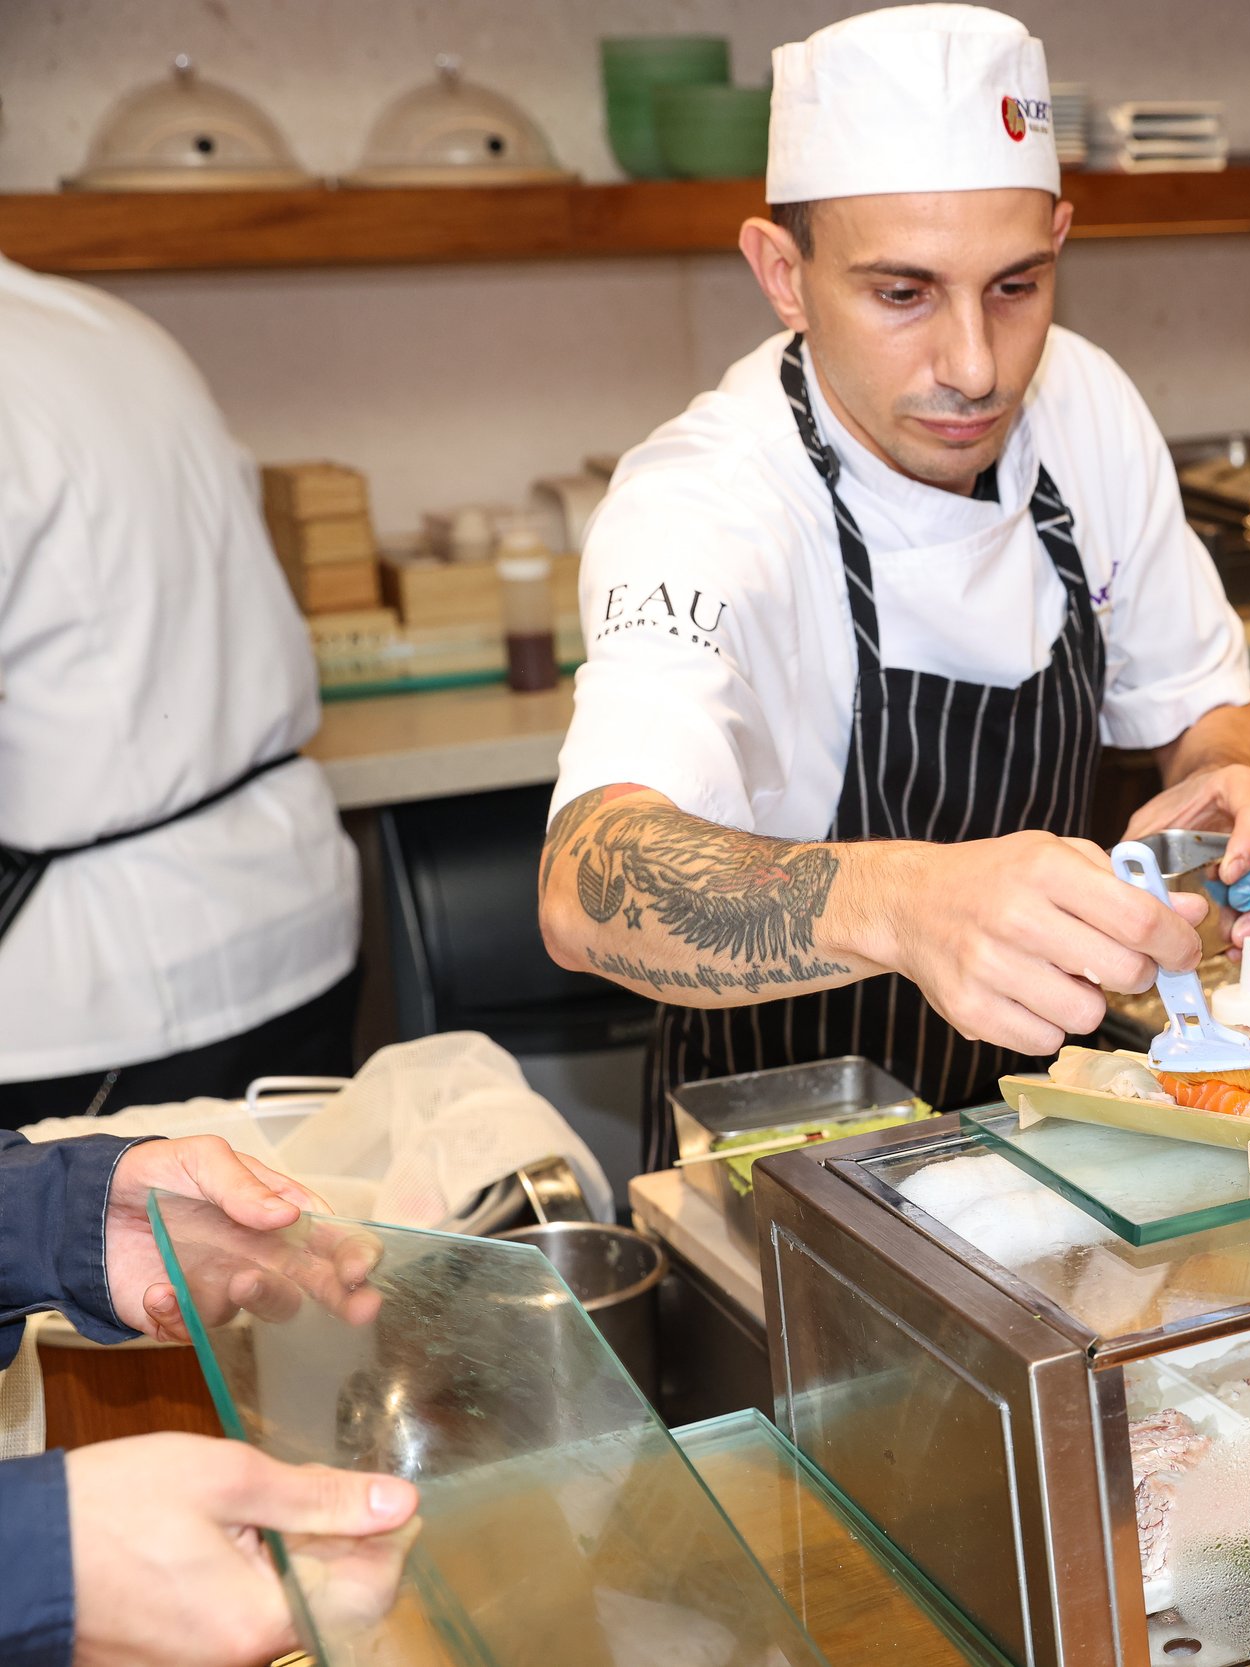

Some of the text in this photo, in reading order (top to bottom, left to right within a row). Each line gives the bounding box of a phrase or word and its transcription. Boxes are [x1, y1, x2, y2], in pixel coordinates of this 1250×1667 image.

[604, 582, 727, 632] EAU
[668, 626, 679, 636] &
[691, 634, 721, 656] SPA
